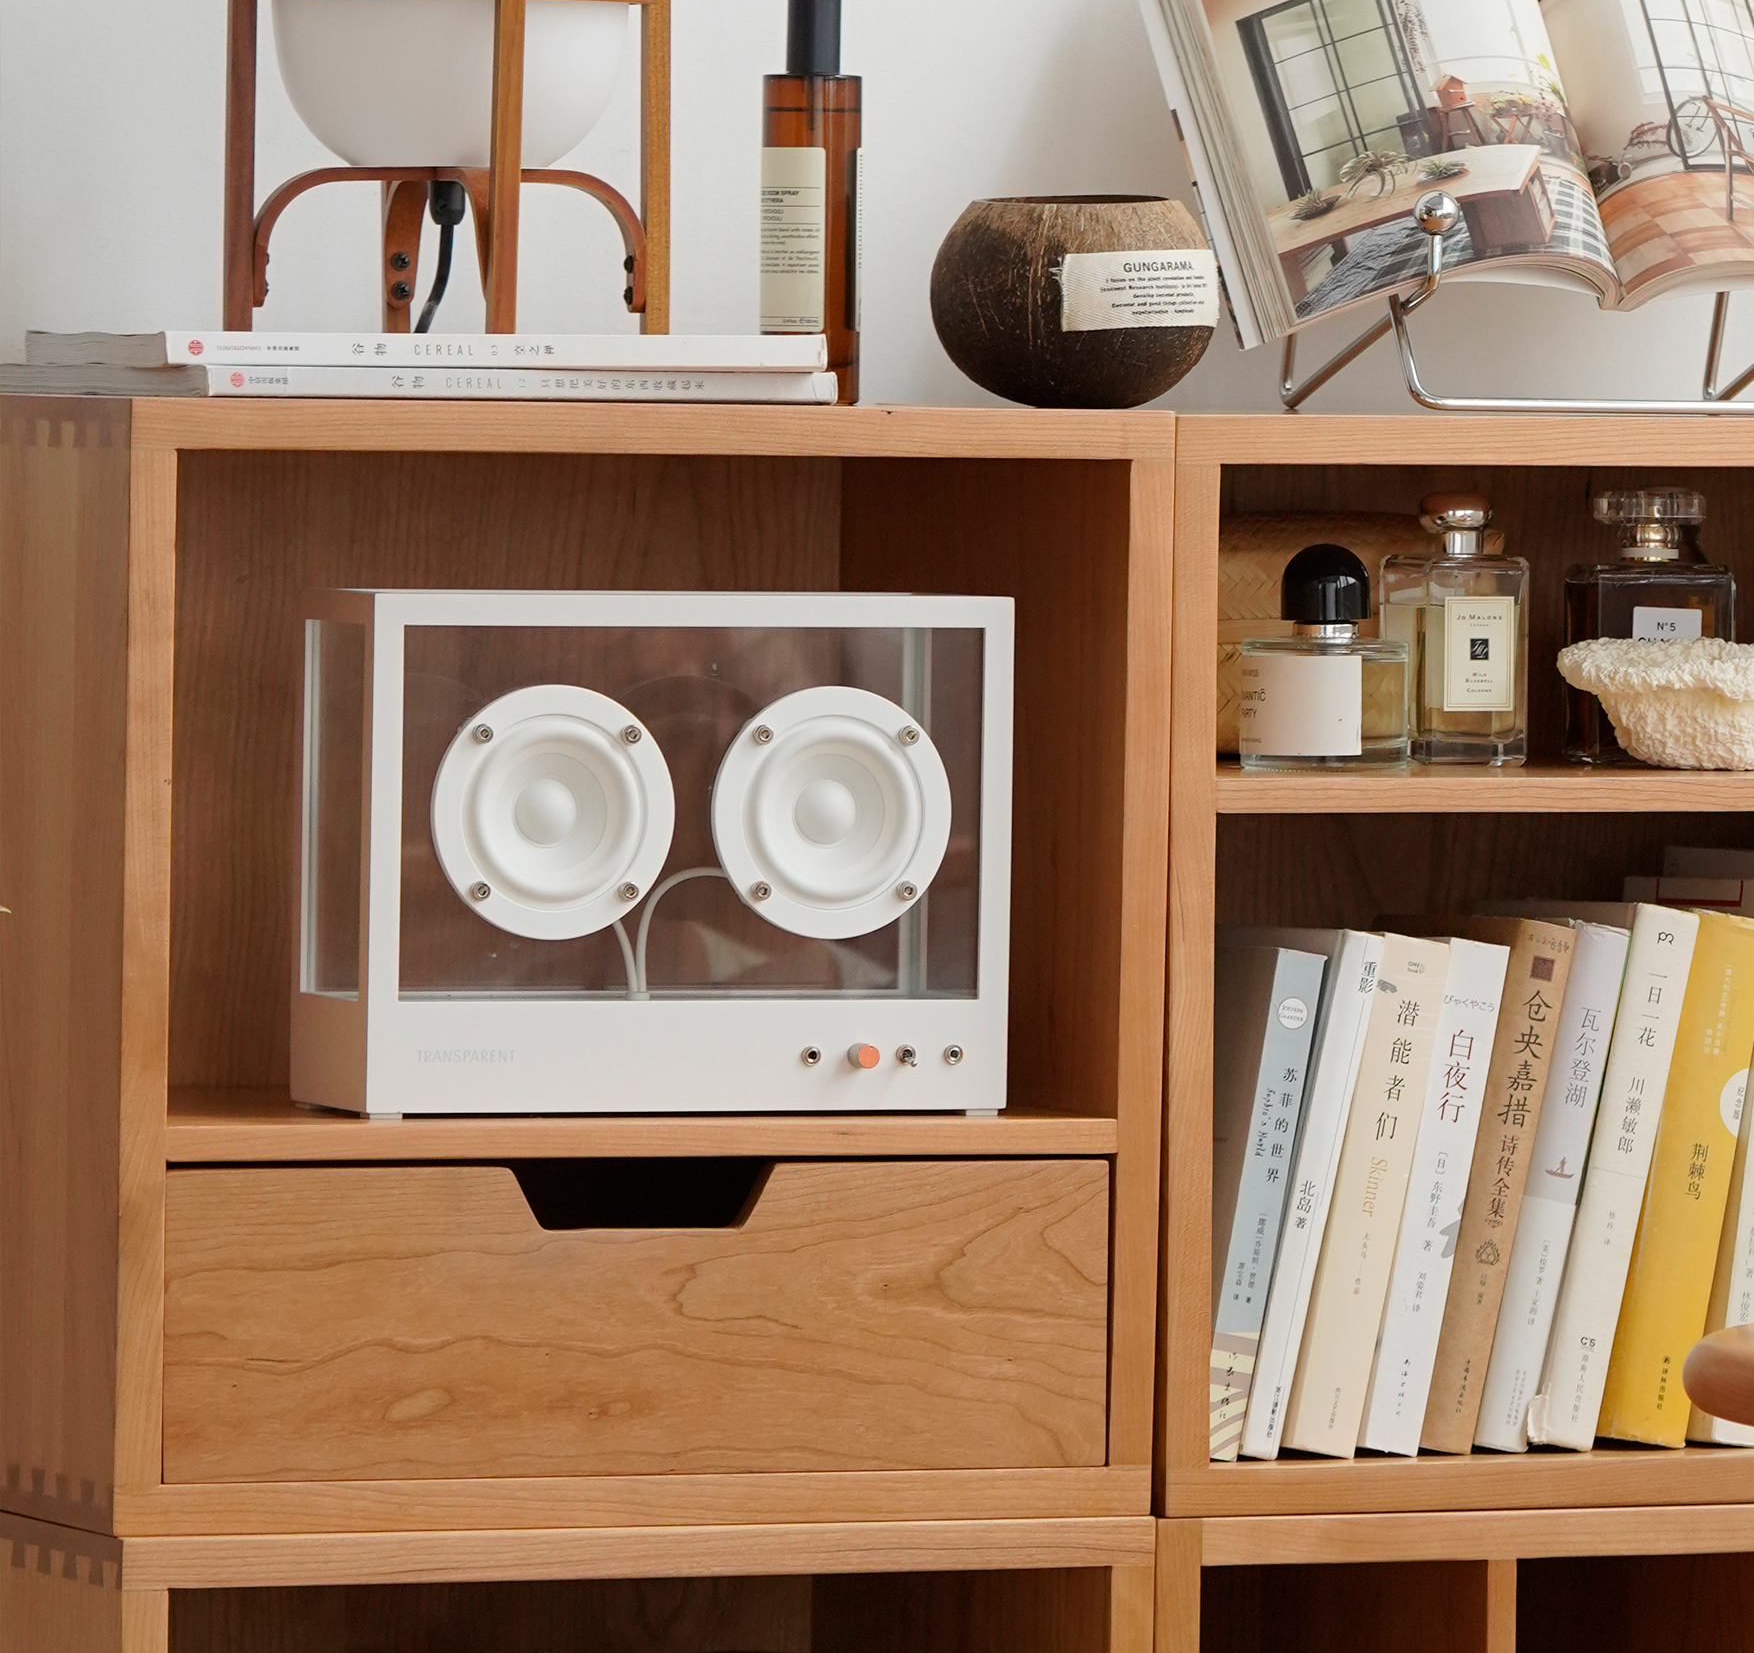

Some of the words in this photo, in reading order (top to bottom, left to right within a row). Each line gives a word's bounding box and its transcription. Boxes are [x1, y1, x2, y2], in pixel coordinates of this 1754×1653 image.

[351, 342, 388, 356] 谷物
[414, 343, 475, 357] CEREAL
[391, 374, 425, 389] 谷物
[445, 376, 504, 390] CEREAL
[1358, 960, 1378, 994] 重影
[1637, 970, 1668, 1049] 一日一花
[416, 1049, 516, 1064] TRANSPARENT
[1375, 999, 1420, 1141] 潜能者们
[1437, 1029, 1475, 1124] 白夜行
[1497, 989, 1553, 1129] 仓央嘉措
[1564, 1006, 1602, 1109] 瓦尔登湖
[1265, 1067, 1299, 1184] 苏菲的世界
[1617, 1077, 1646, 1154] 川濑敏郎
[1732, 1086, 1745, 1121] 纪念版
[1296, 1180, 1317, 1214] 北岛
[1361, 1156, 1388, 1217] Skinner
[1487, 1134, 1520, 1219] 诗传全集
[1684, 1143, 1709, 1201] 荆棘鸟
[1426, 1180, 1443, 1229] 东野圭吾
